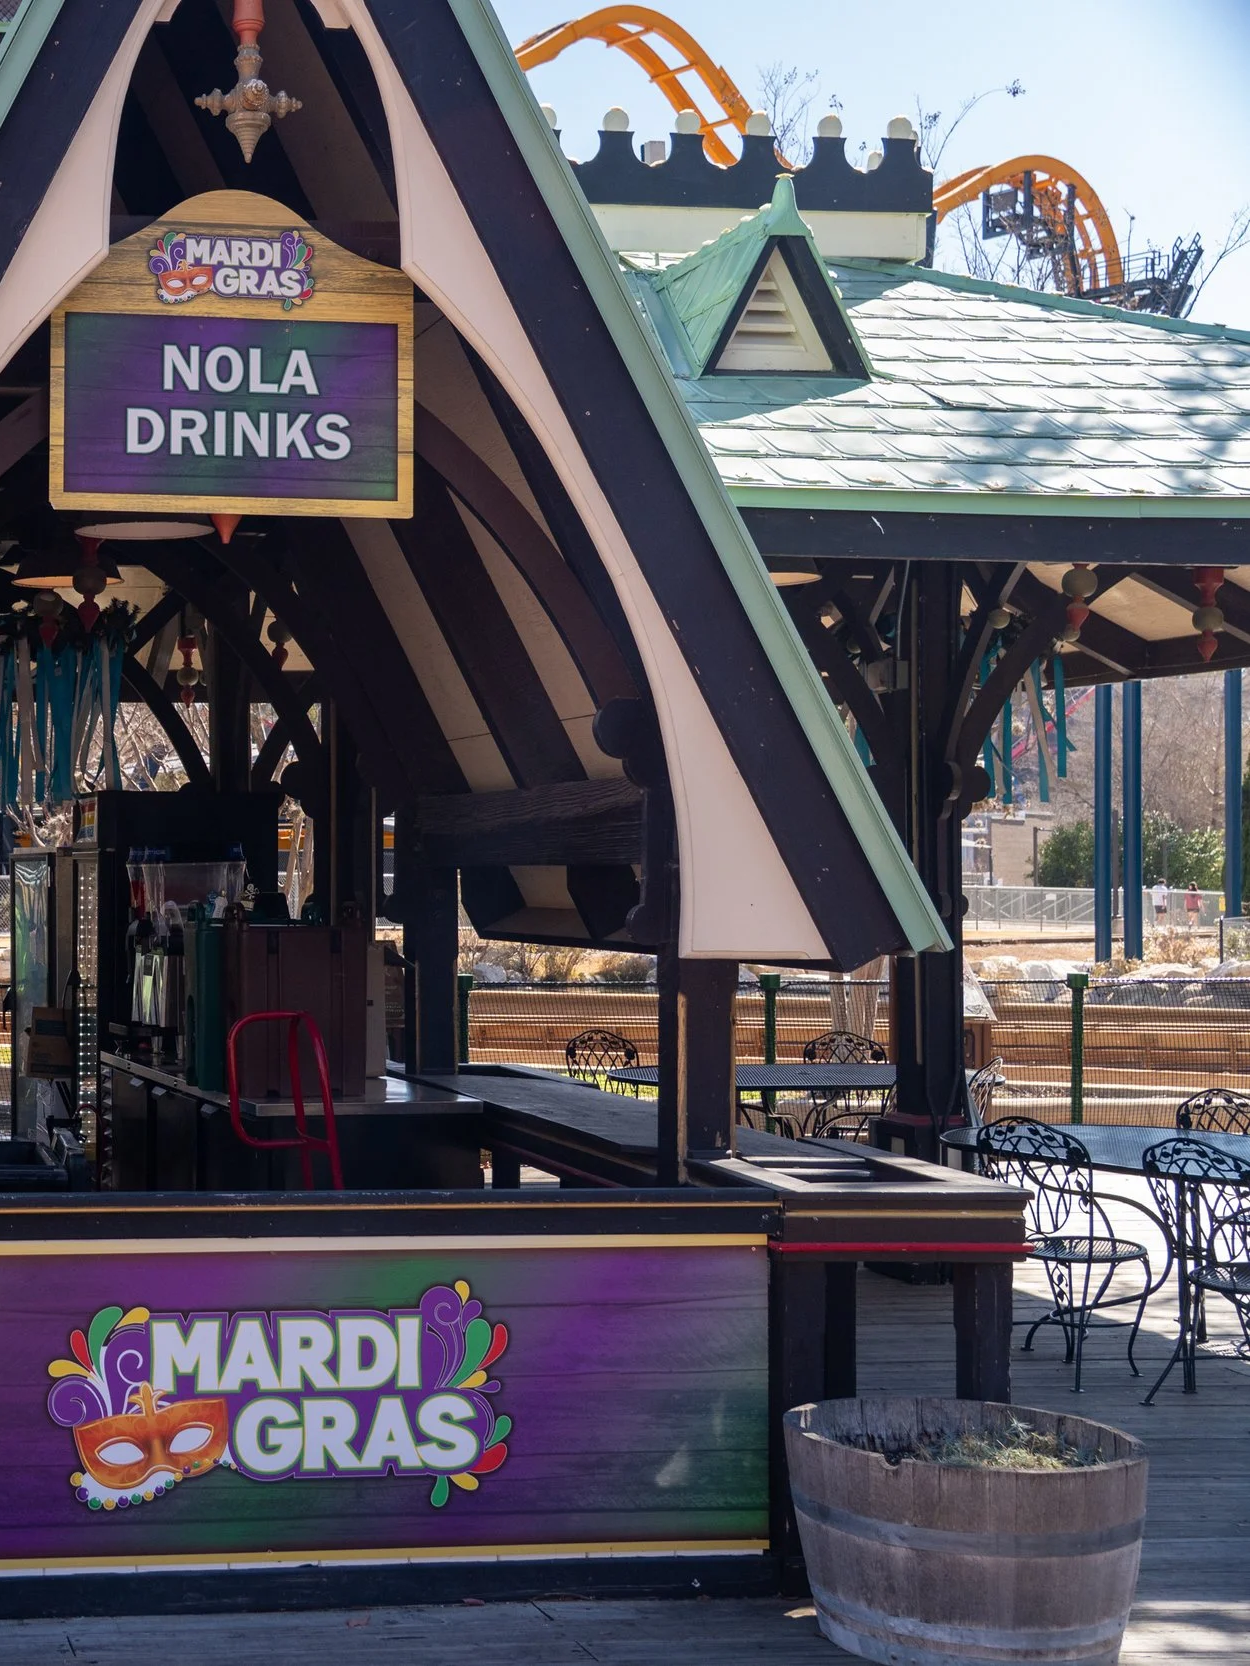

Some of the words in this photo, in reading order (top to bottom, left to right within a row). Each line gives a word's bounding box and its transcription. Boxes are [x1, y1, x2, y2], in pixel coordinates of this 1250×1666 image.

[185, 237, 282, 268] MARDI
[214, 267, 302, 298] GRAS
[163, 344, 320, 396] NOLA
[126, 407, 352, 461] DRINKS
[151, 1315, 423, 1396] MARDI
[234, 1392, 480, 1475] GRAS
